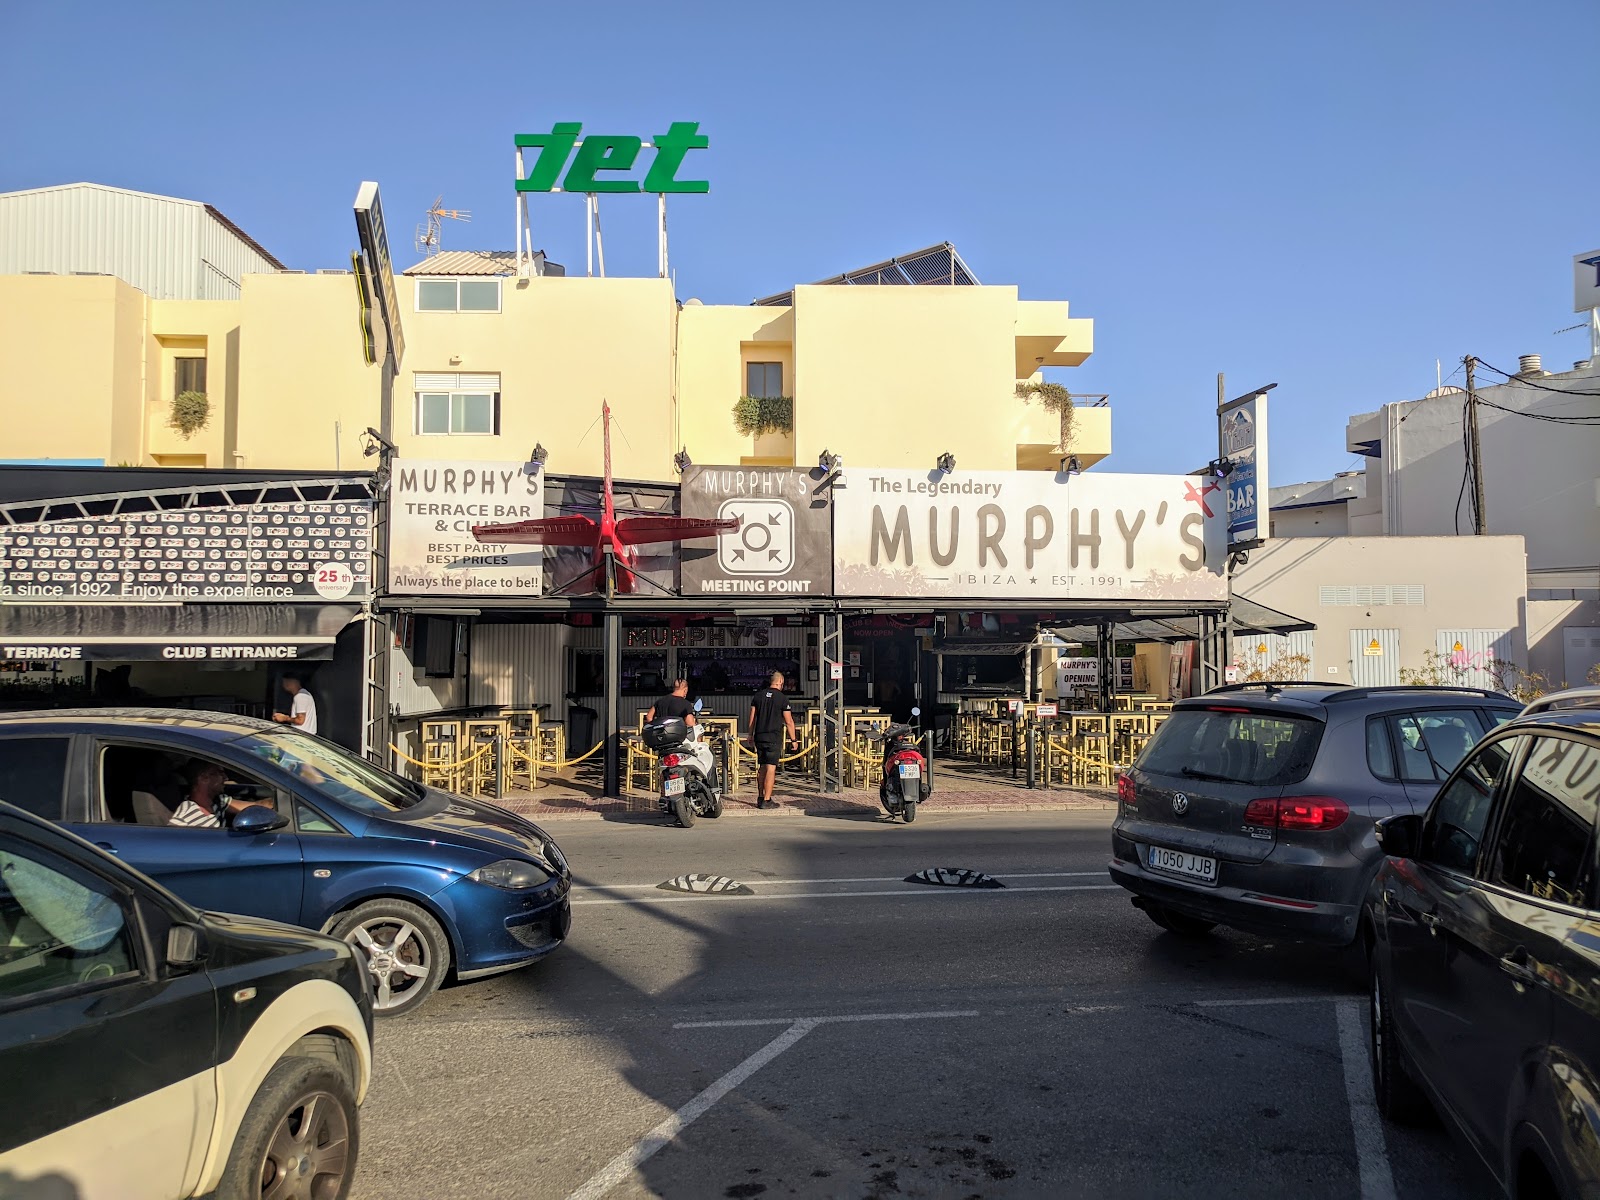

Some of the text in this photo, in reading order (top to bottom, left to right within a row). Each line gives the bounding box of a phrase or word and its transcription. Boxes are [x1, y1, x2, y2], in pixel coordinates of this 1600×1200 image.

[400, 468, 538, 496] MURPHY'S
[704, 469, 807, 495] MURPHY'S
[869, 478, 1002, 498] The Legendary
[1226, 484, 1255, 512] BAR
[404, 503, 531, 518] TERRACE BAR
[435, 520, 448, 532] &
[870, 501, 1206, 570] MURPHY'S
[428, 544, 507, 553] BEST PARTY
[427, 555, 508, 564] BEST PRICES
[319, 570, 338, 582] 25
[342, 574, 350, 582] th
[394, 575, 538, 590] Always the place to be!!
[958, 574, 1017, 585] IBIZA
[1090, 576, 1123, 586] 1991
[18, 582, 63, 596] since
[70, 583, 115, 596] 1992.
[121, 583, 168, 600] Enjoy
[172, 583, 199, 596] the
[204, 583, 294, 600] experience
[701, 579, 811, 592] MEETING POINT
[628, 628, 769, 646] MURPHY'S
[4, 647, 82, 658] TERRACE
[163, 647, 297, 658] CLUB ENTRANCE
[1061, 660, 1097, 669] MURPHY'S
[1158, 850, 1183, 868] 1050
[1188, 857, 1212, 874] JJB
